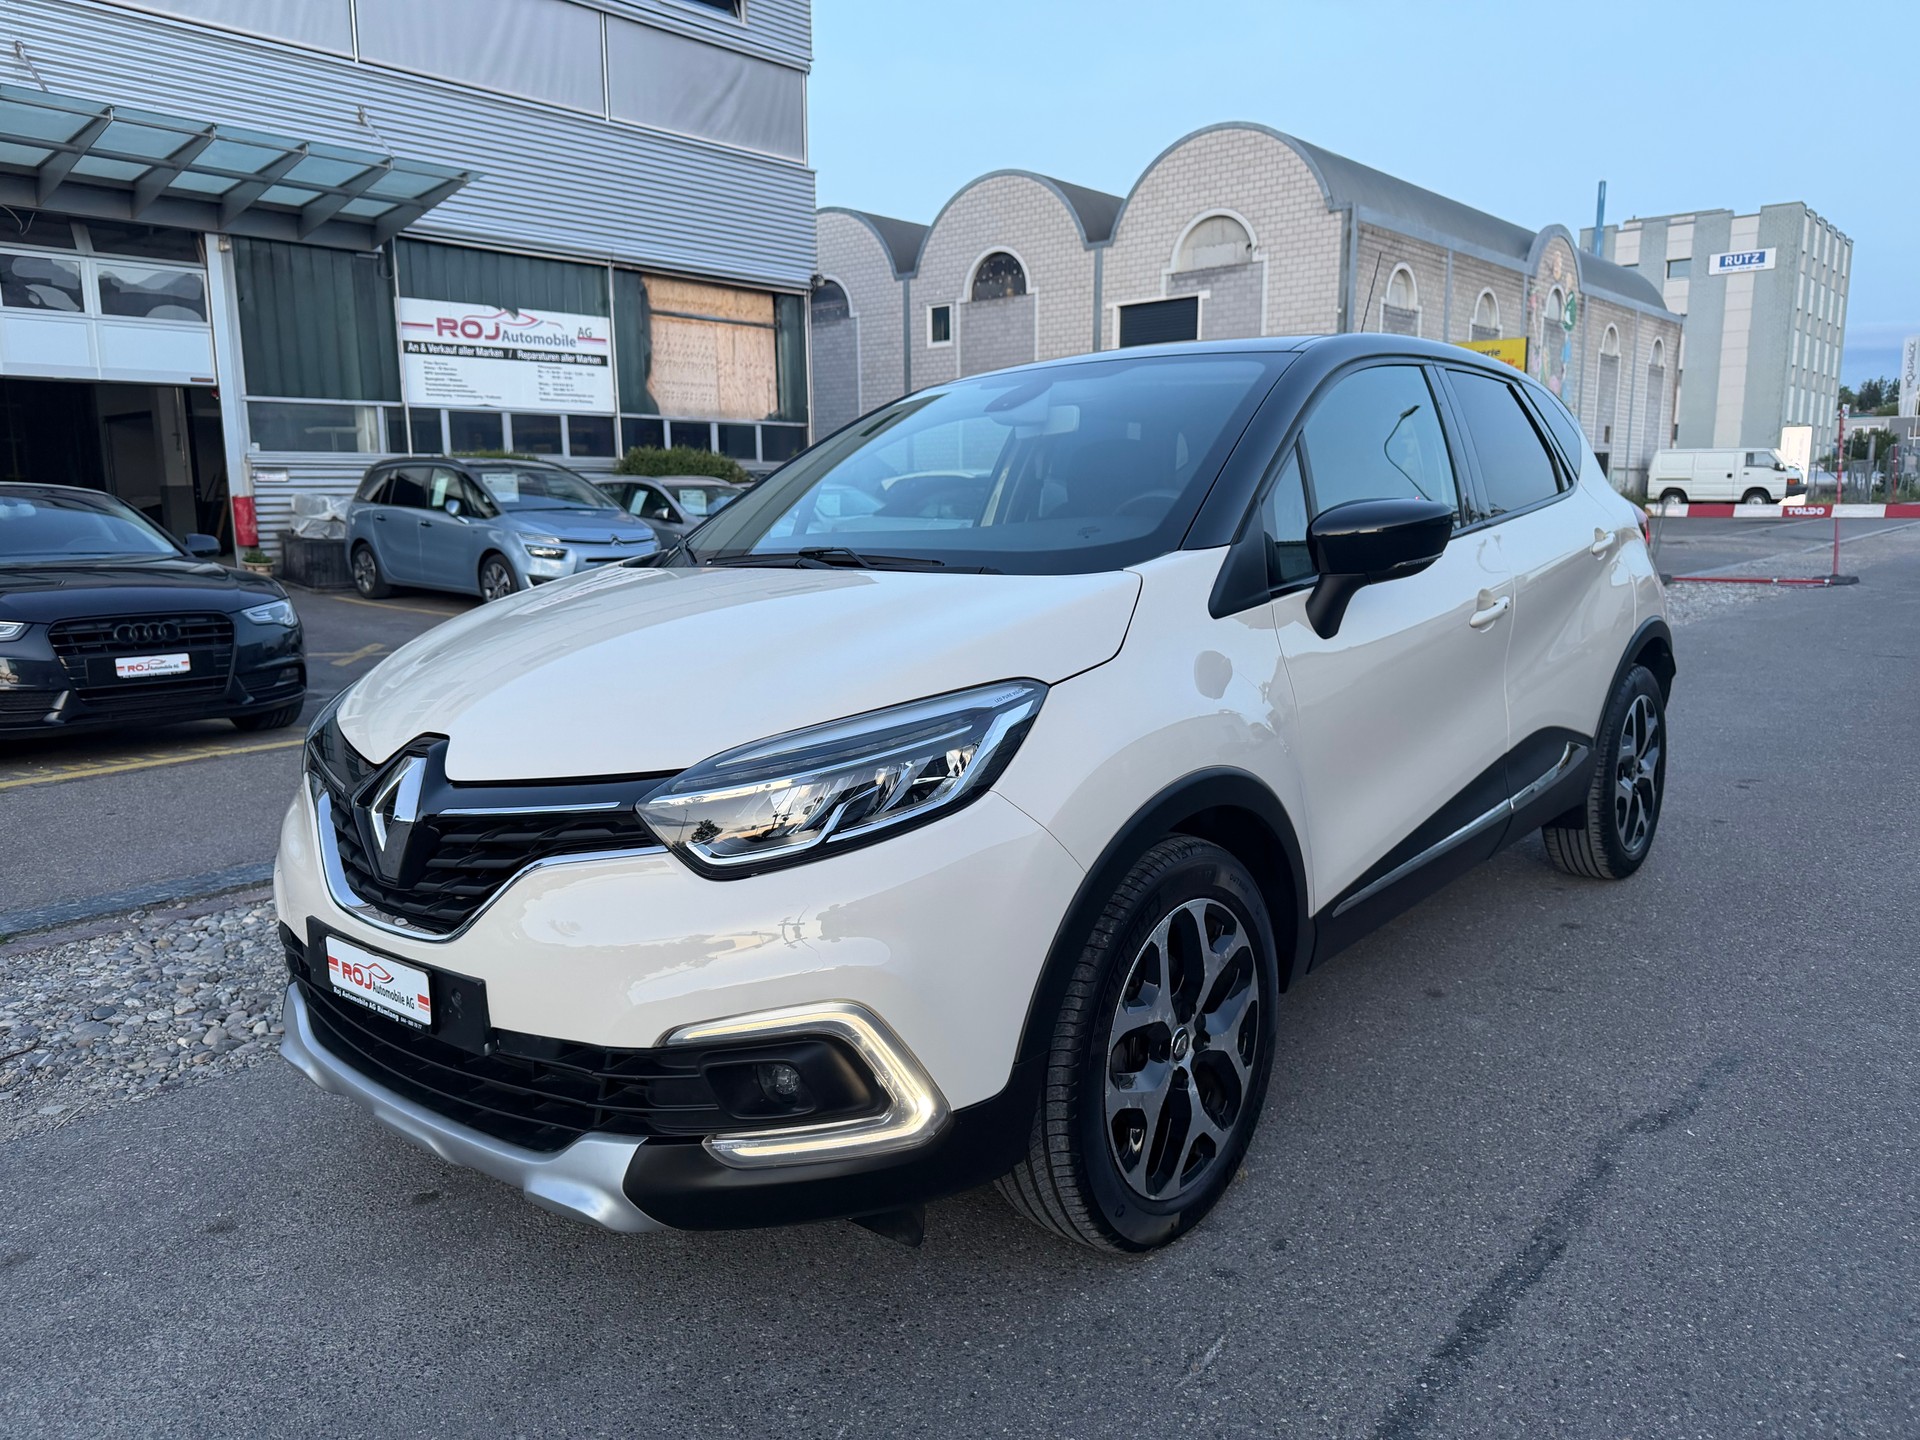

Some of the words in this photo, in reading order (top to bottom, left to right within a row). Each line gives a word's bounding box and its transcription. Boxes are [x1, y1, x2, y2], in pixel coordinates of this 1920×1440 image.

[1724, 252, 1760, 266] RUTZ
[436, 317, 500, 340] ROJ
[502, 329, 576, 348] Automobile
[577, 326, 592, 338] AG
[407, 341, 419, 353] An
[420, 342, 427, 354] &
[427, 342, 458, 356] Verkauf
[458, 345, 475, 357] aller
[475, 346, 504, 359] Marken
[517, 349, 561, 362] Reparaturen
[561, 352, 576, 364] aller
[575, 353, 602, 365] Marken
[1787, 506, 1825, 516] TOLDO
[127, 663, 150, 672] ROJ
[341, 961, 373, 990] ROJ
[372, 981, 406, 1006] Automobile
[405, 995, 415, 1010] AG
[333, 985, 342, 997] Roj
[342, 990, 369, 1008] Automobile
[368, 1001, 377, 1011] AG
